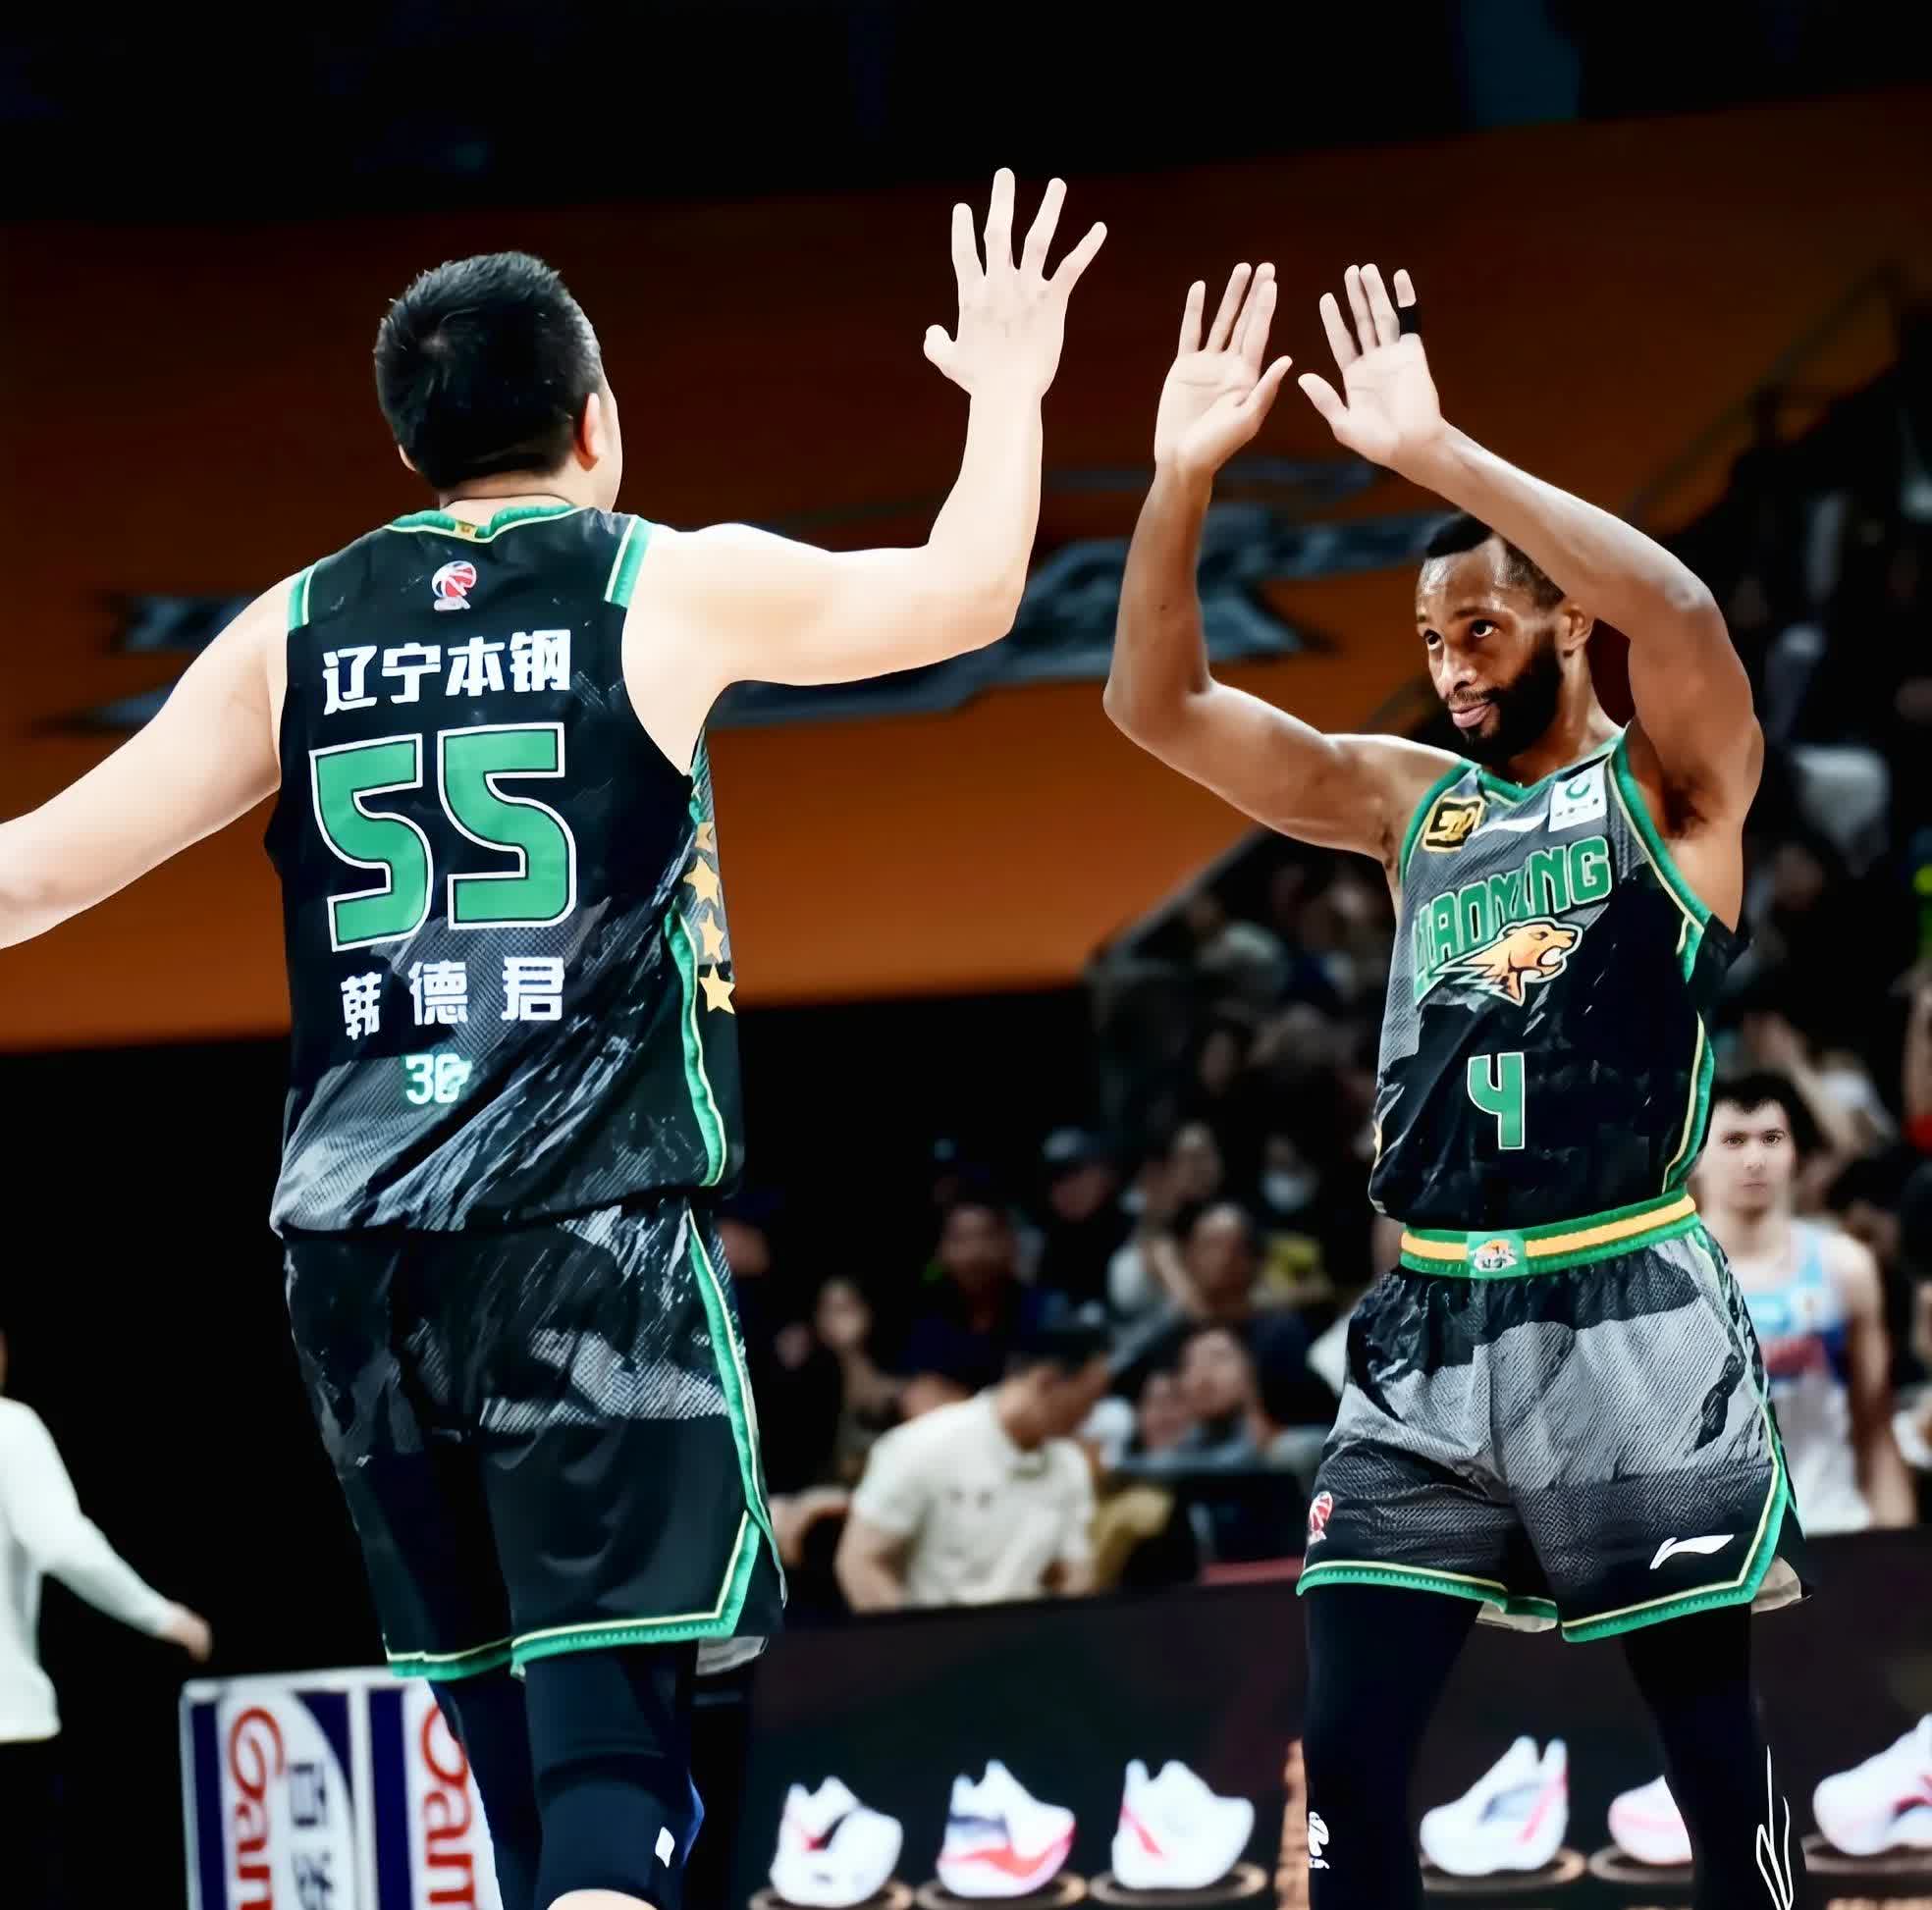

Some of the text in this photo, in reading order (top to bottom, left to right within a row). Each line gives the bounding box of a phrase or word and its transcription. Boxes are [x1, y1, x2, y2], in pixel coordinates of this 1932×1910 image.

[322, 629, 571, 716] 辽宁本钢
[308, 722, 576, 952] 55
[341, 957, 565, 1040] 韩德君
[1467, 1052, 1526, 1150] 4
